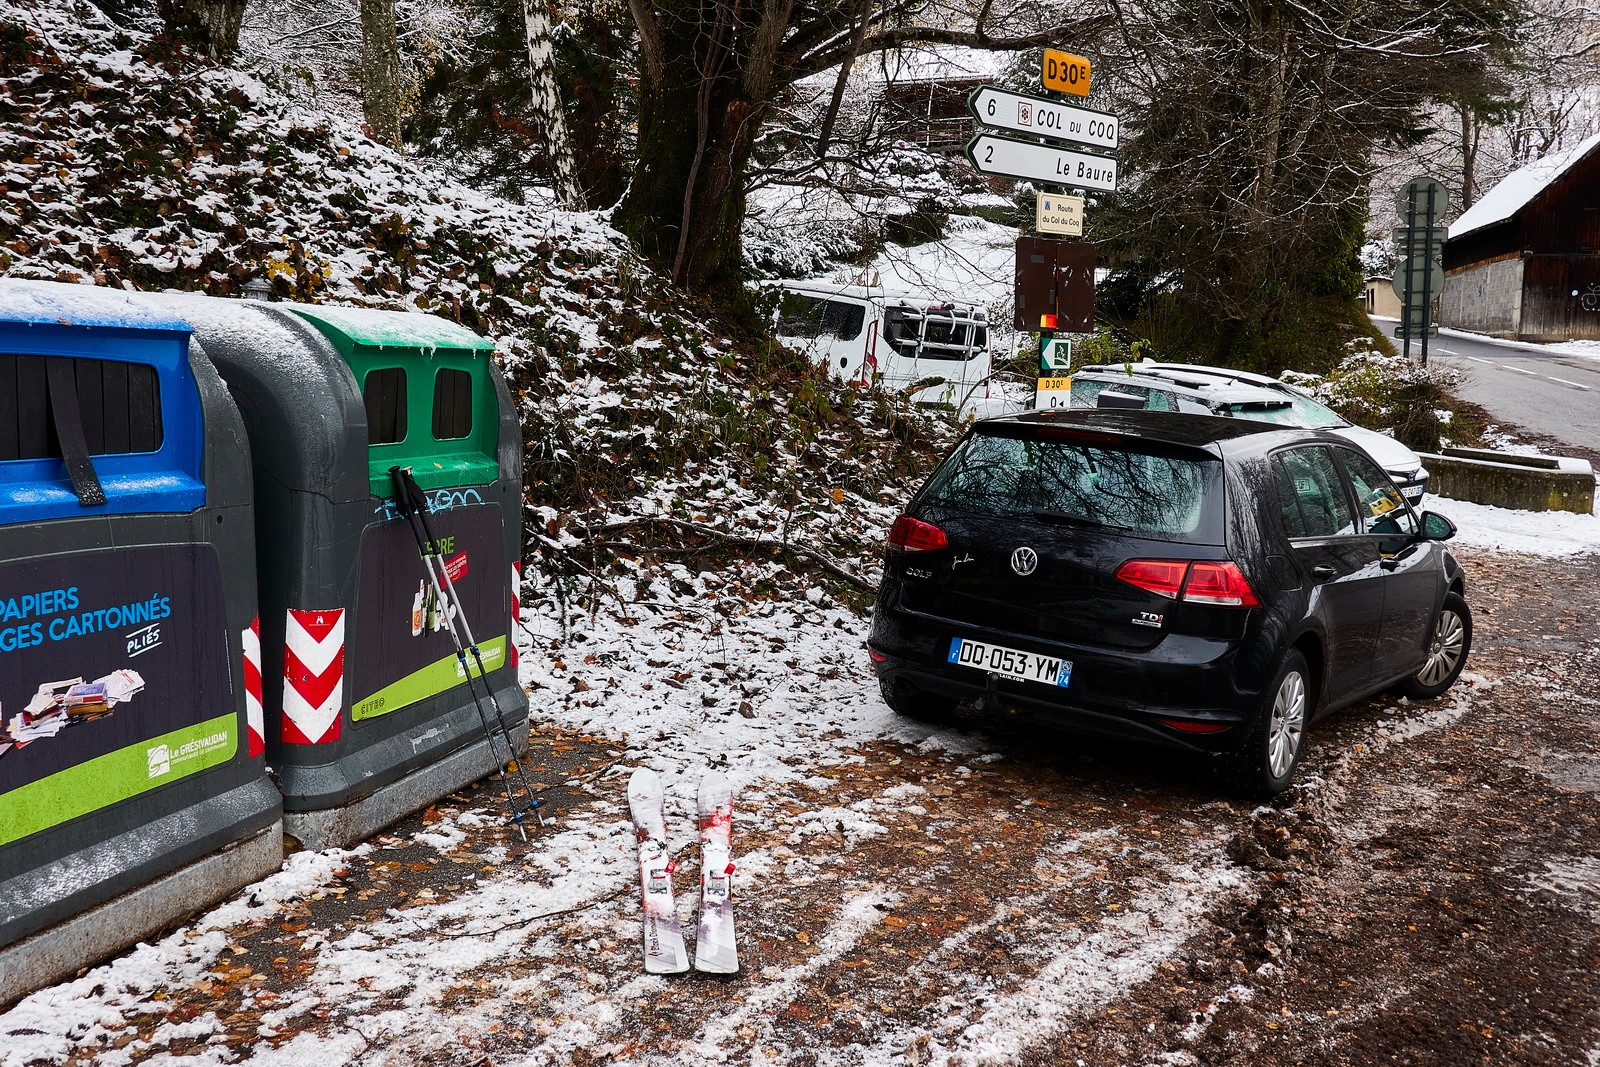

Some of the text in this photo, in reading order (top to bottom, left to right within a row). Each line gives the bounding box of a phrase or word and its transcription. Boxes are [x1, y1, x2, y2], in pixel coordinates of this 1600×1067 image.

[987, 98, 1115, 140] 6 COL DU COQ
[984, 145, 1113, 183] 2 Le Baure
[1042, 215, 1080, 228] du Col du Coq
[1057, 204, 1074, 214] Route
[1050, 396, 1057, 408] 0
[49, 593, 171, 641] CARTONNÉS
[1140, 611, 1164, 622] TDI
[127, 626, 161, 653] PLIÉS
[959, 641, 1060, 683] DQ-053-YM
[1058, 673, 1069, 685] 74
[361, 697, 385, 714] CITEO
[170, 730, 227, 760] Le GRÉSIVAUDAN
